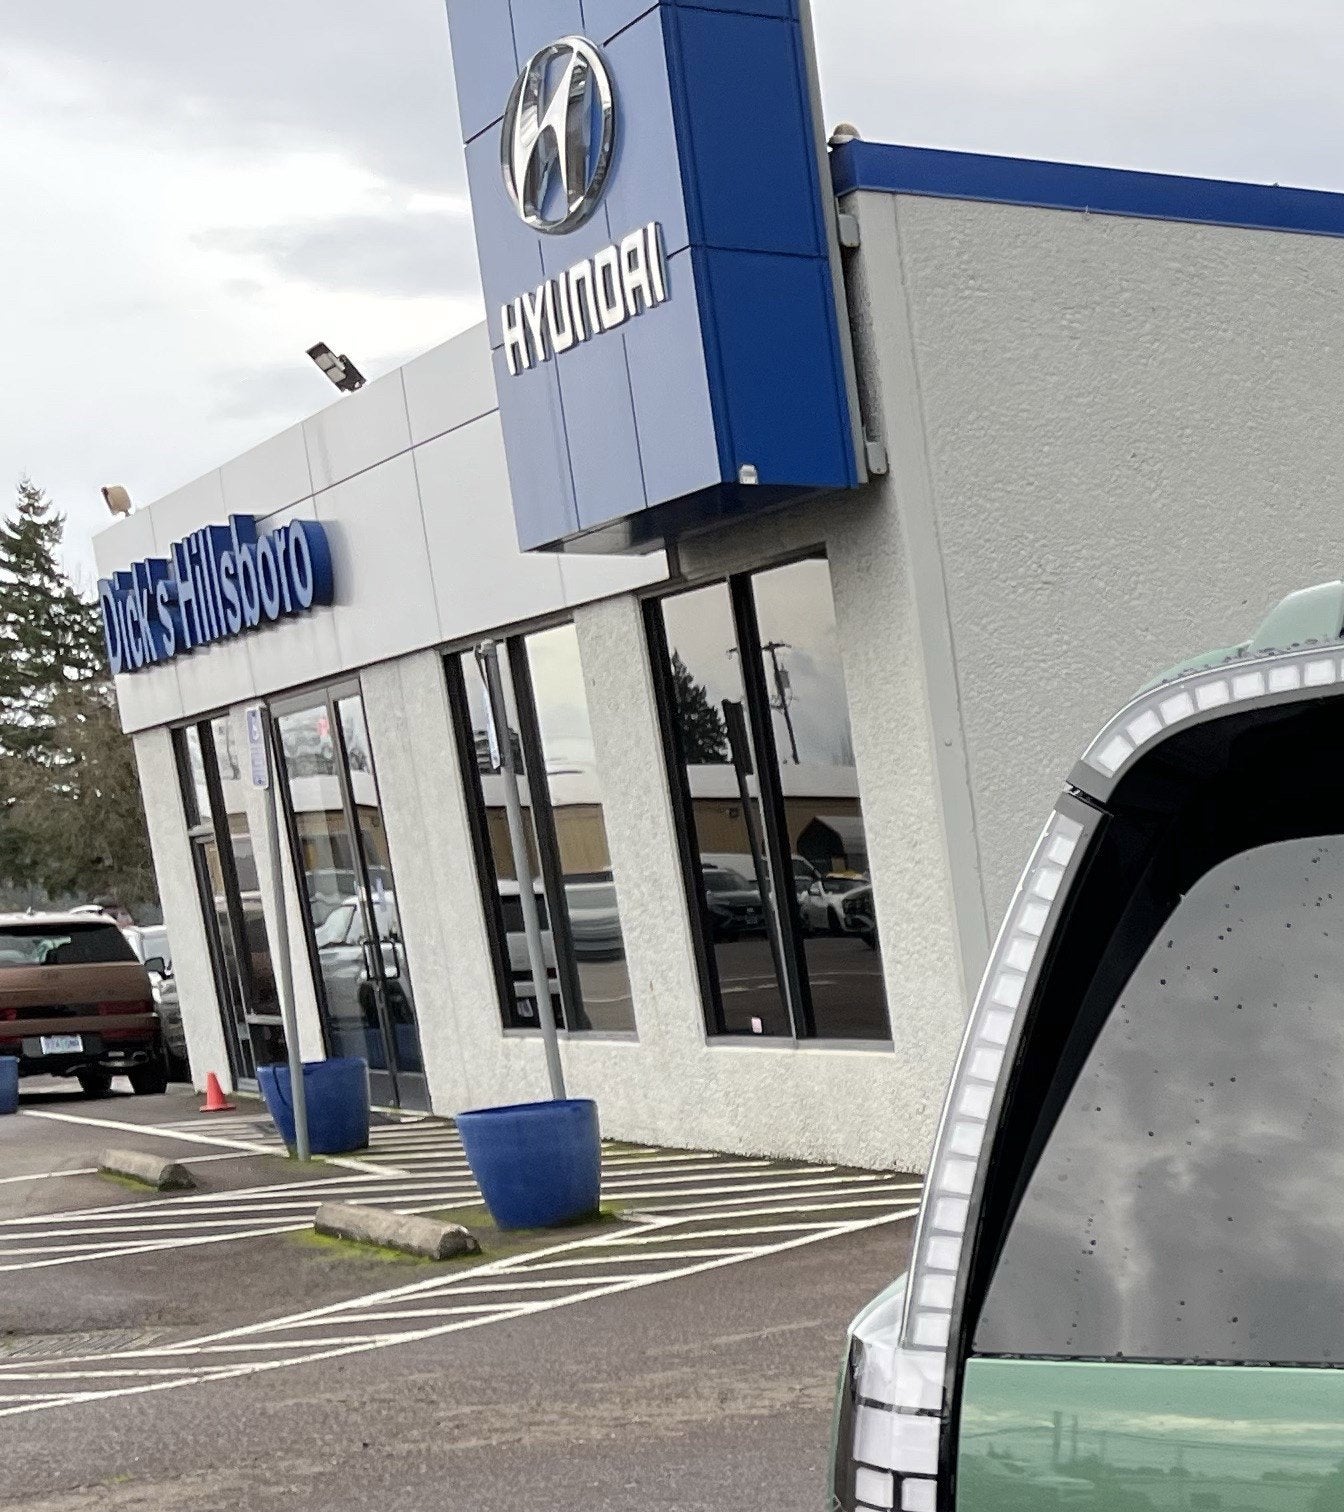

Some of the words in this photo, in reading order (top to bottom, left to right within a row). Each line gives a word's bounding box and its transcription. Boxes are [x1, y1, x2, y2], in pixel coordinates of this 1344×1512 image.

[501, 222, 667, 376] HYUNDAI
[100, 560, 176, 676] Dick's
[171, 515, 317, 650] Hillsboro
